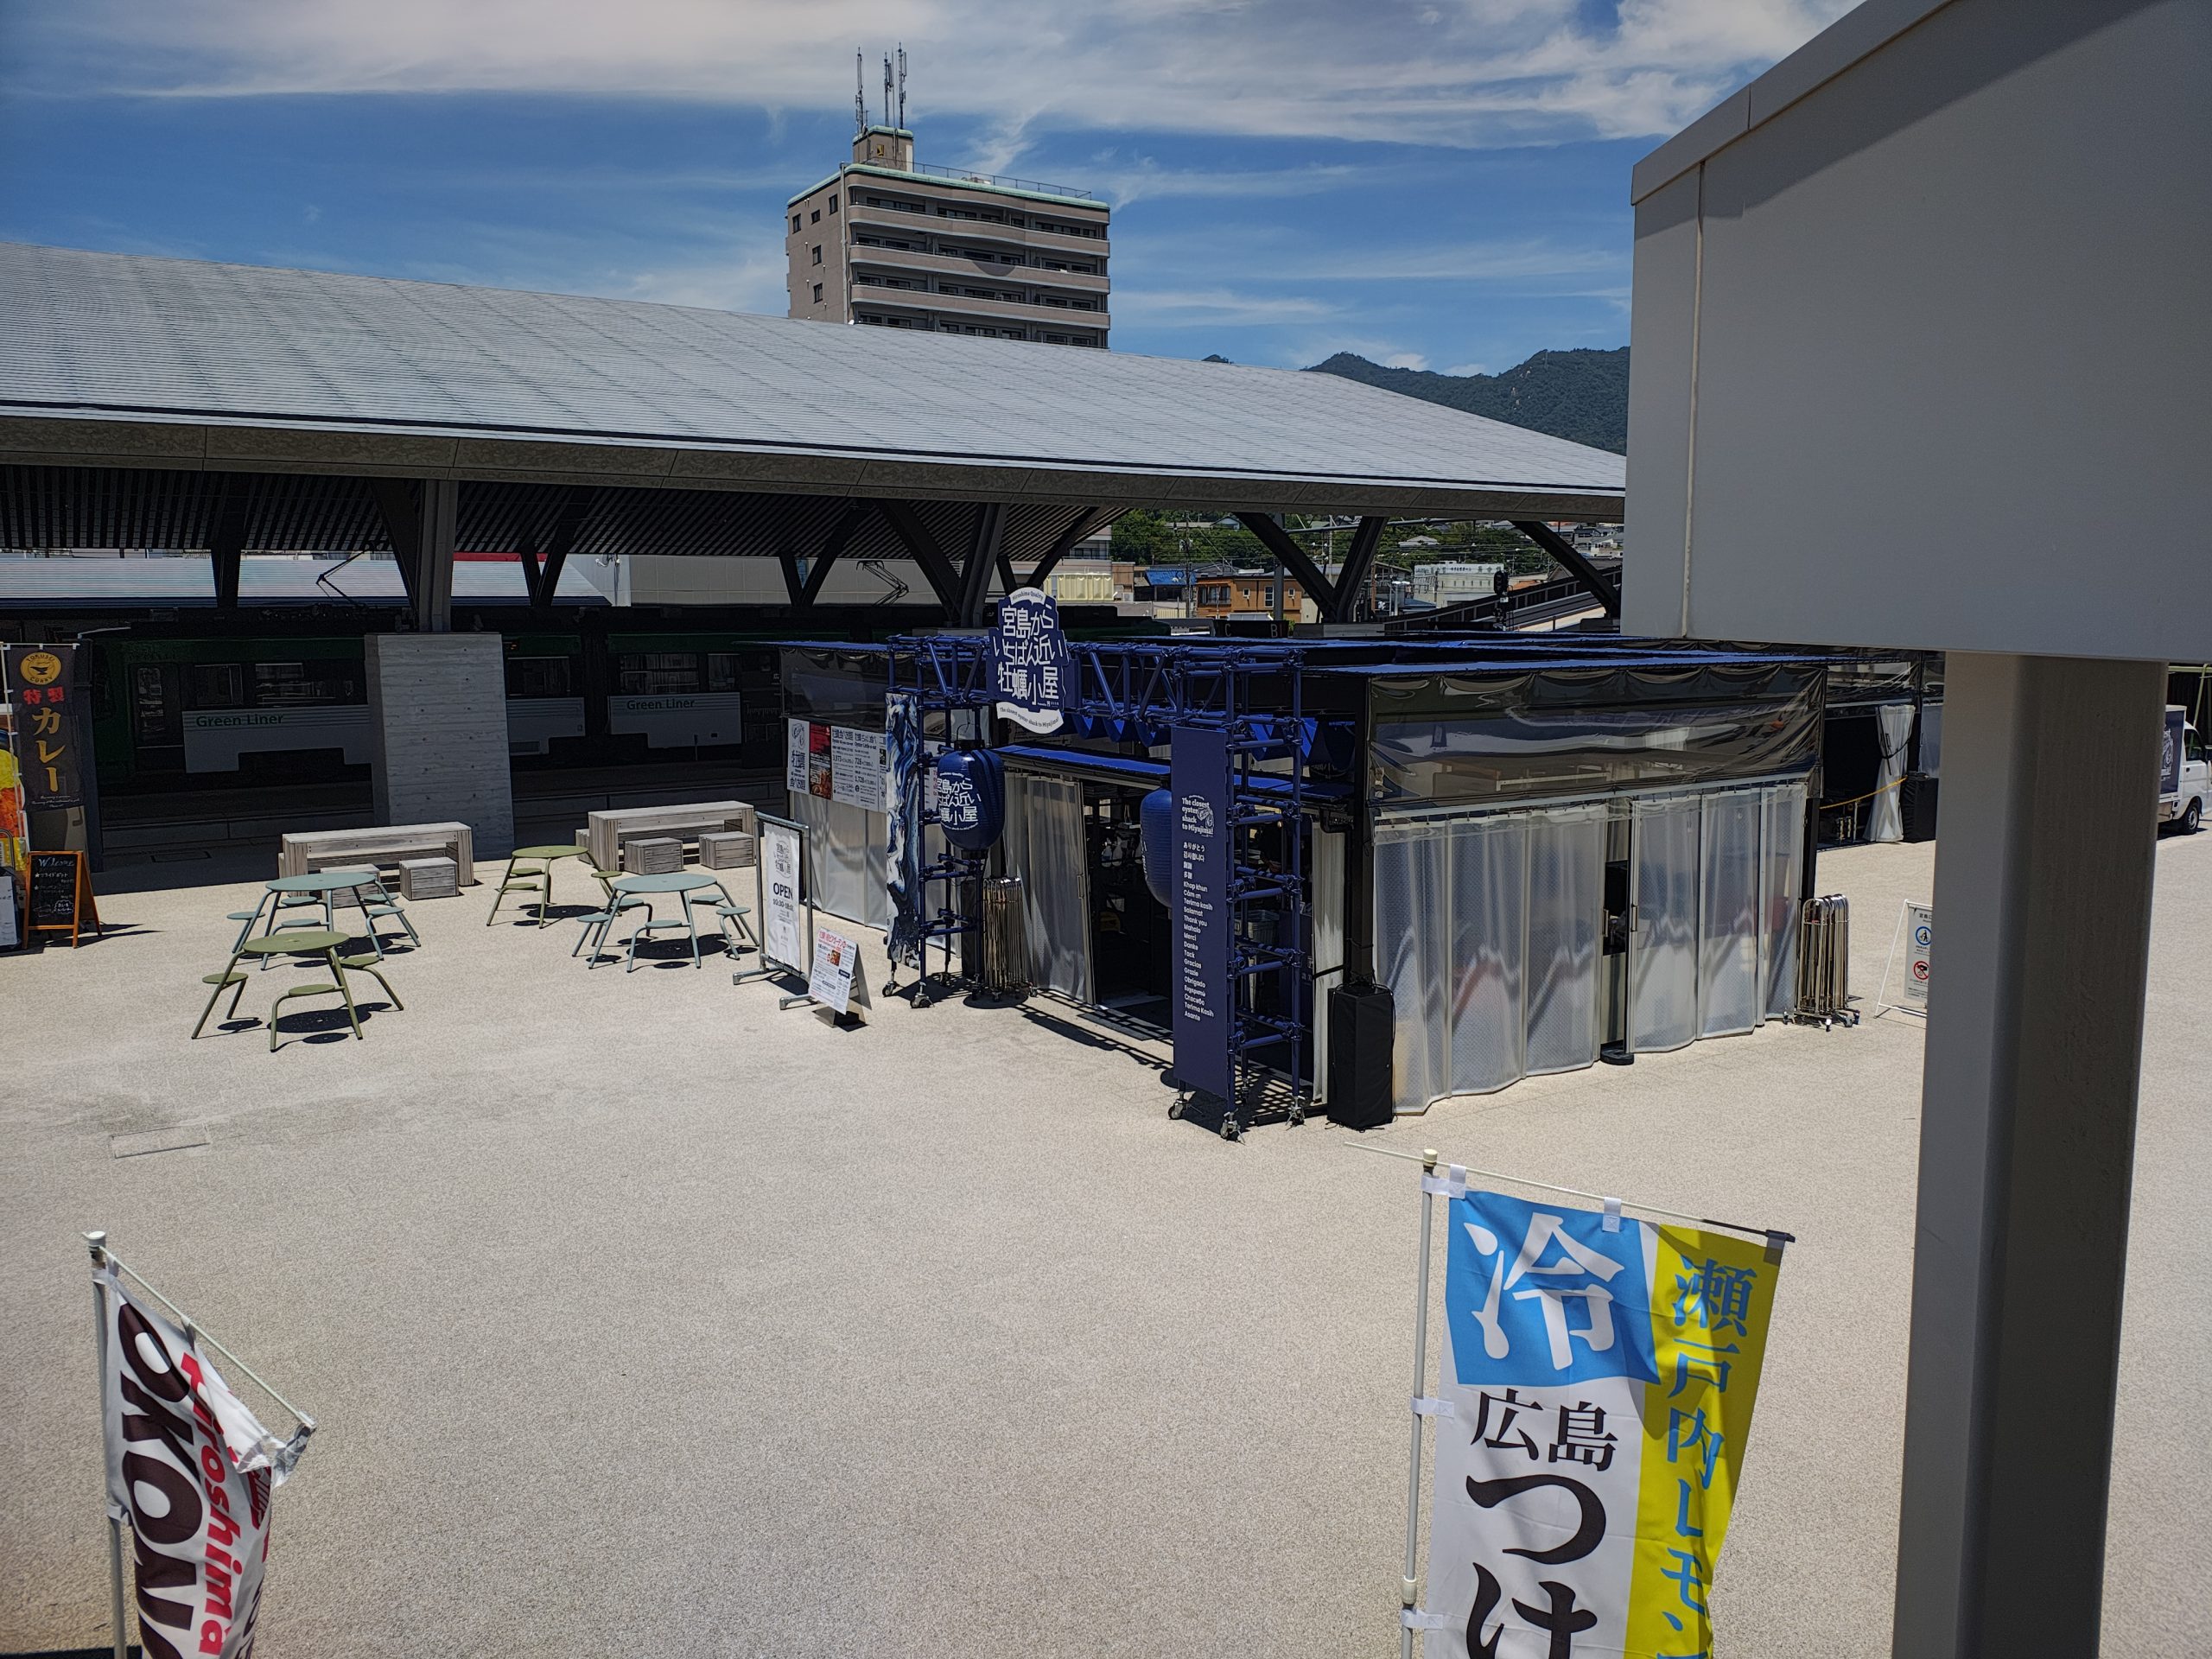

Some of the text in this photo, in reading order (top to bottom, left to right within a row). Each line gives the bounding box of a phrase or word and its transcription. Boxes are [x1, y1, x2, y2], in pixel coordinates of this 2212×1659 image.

[1002, 604, 1053, 639] 宮島から
[993, 633, 1064, 666] いちばん近い
[998, 661, 1059, 705] 牡蠣小屋
[23, 686, 65, 705] 特製
[627, 698, 696, 710] Green Liner
[196, 713, 283, 727] Green Liner
[32, 707, 66, 792] カレー
[1182, 797, 1192, 806] The
[938, 805, 979, 826] 蠣小屋
[1183, 842, 1205, 852] ありがとう
[773, 882, 793, 900] OPEN
[1184, 914, 1198, 925] Thank
[1184, 923, 1201, 934] Mahalo
[1184, 931, 1197, 942] Merci
[1184, 949, 1196, 959] Tack
[1184, 958, 1202, 969] Gracias
[1184, 976, 1206, 988] Obrigado
[1464, 1211, 1625, 1371] 冷
[1470, 1387, 1618, 1472] 広島
